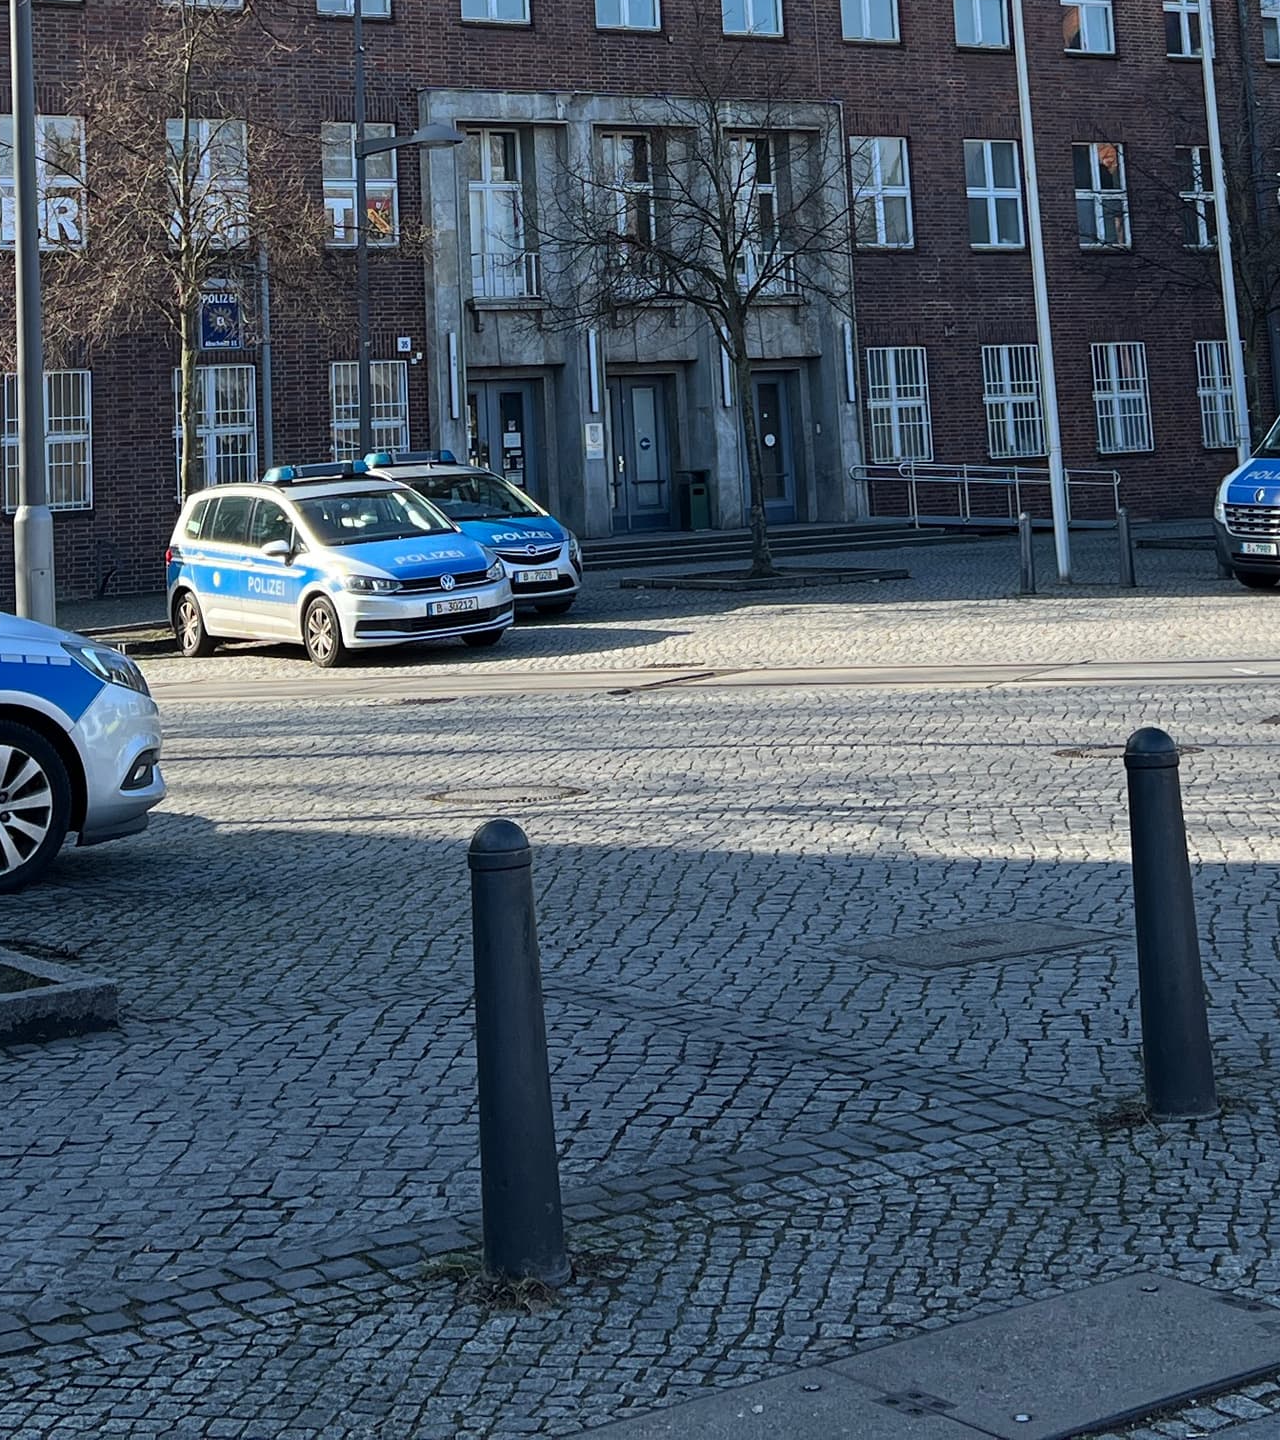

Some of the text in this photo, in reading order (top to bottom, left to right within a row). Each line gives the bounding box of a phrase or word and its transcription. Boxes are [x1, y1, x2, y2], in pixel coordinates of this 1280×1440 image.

[202, 293, 238, 304] POLIZEI
[401, 341, 409, 349] 35
[491, 531, 555, 544] POLIZEI
[394, 550, 466, 565] POLIZEI
[248, 576, 285, 596] POLIZEI
[436, 603, 443, 613] B
